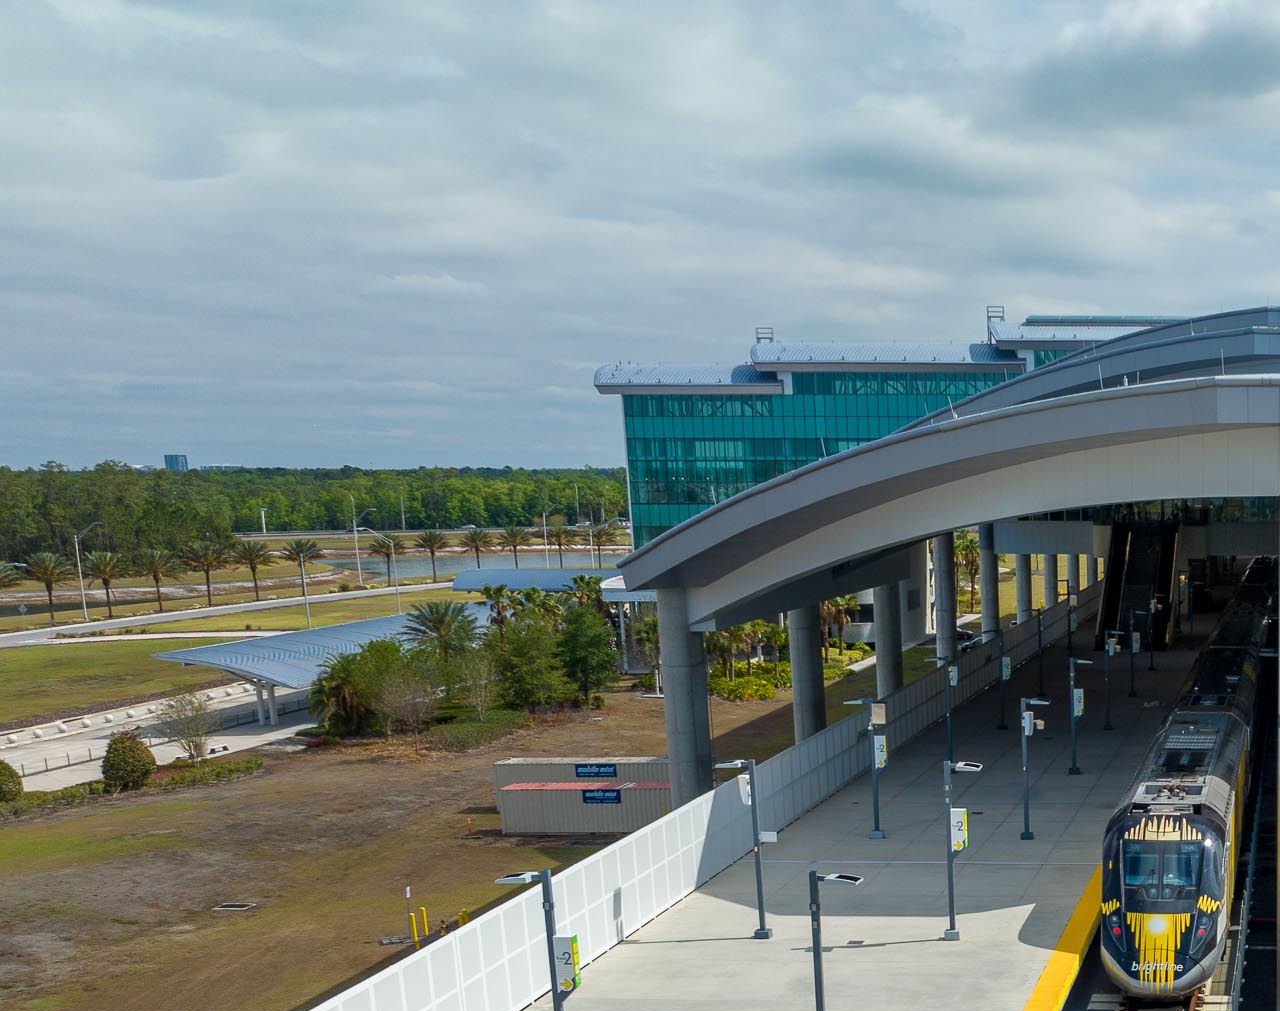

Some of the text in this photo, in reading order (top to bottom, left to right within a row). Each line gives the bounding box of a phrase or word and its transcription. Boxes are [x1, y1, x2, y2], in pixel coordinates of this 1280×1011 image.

[880, 743, 885, 753] 2
[956, 820, 964, 832] 2
[562, 951, 572, 966] 2
[1131, 960, 1184, 975] brightline
